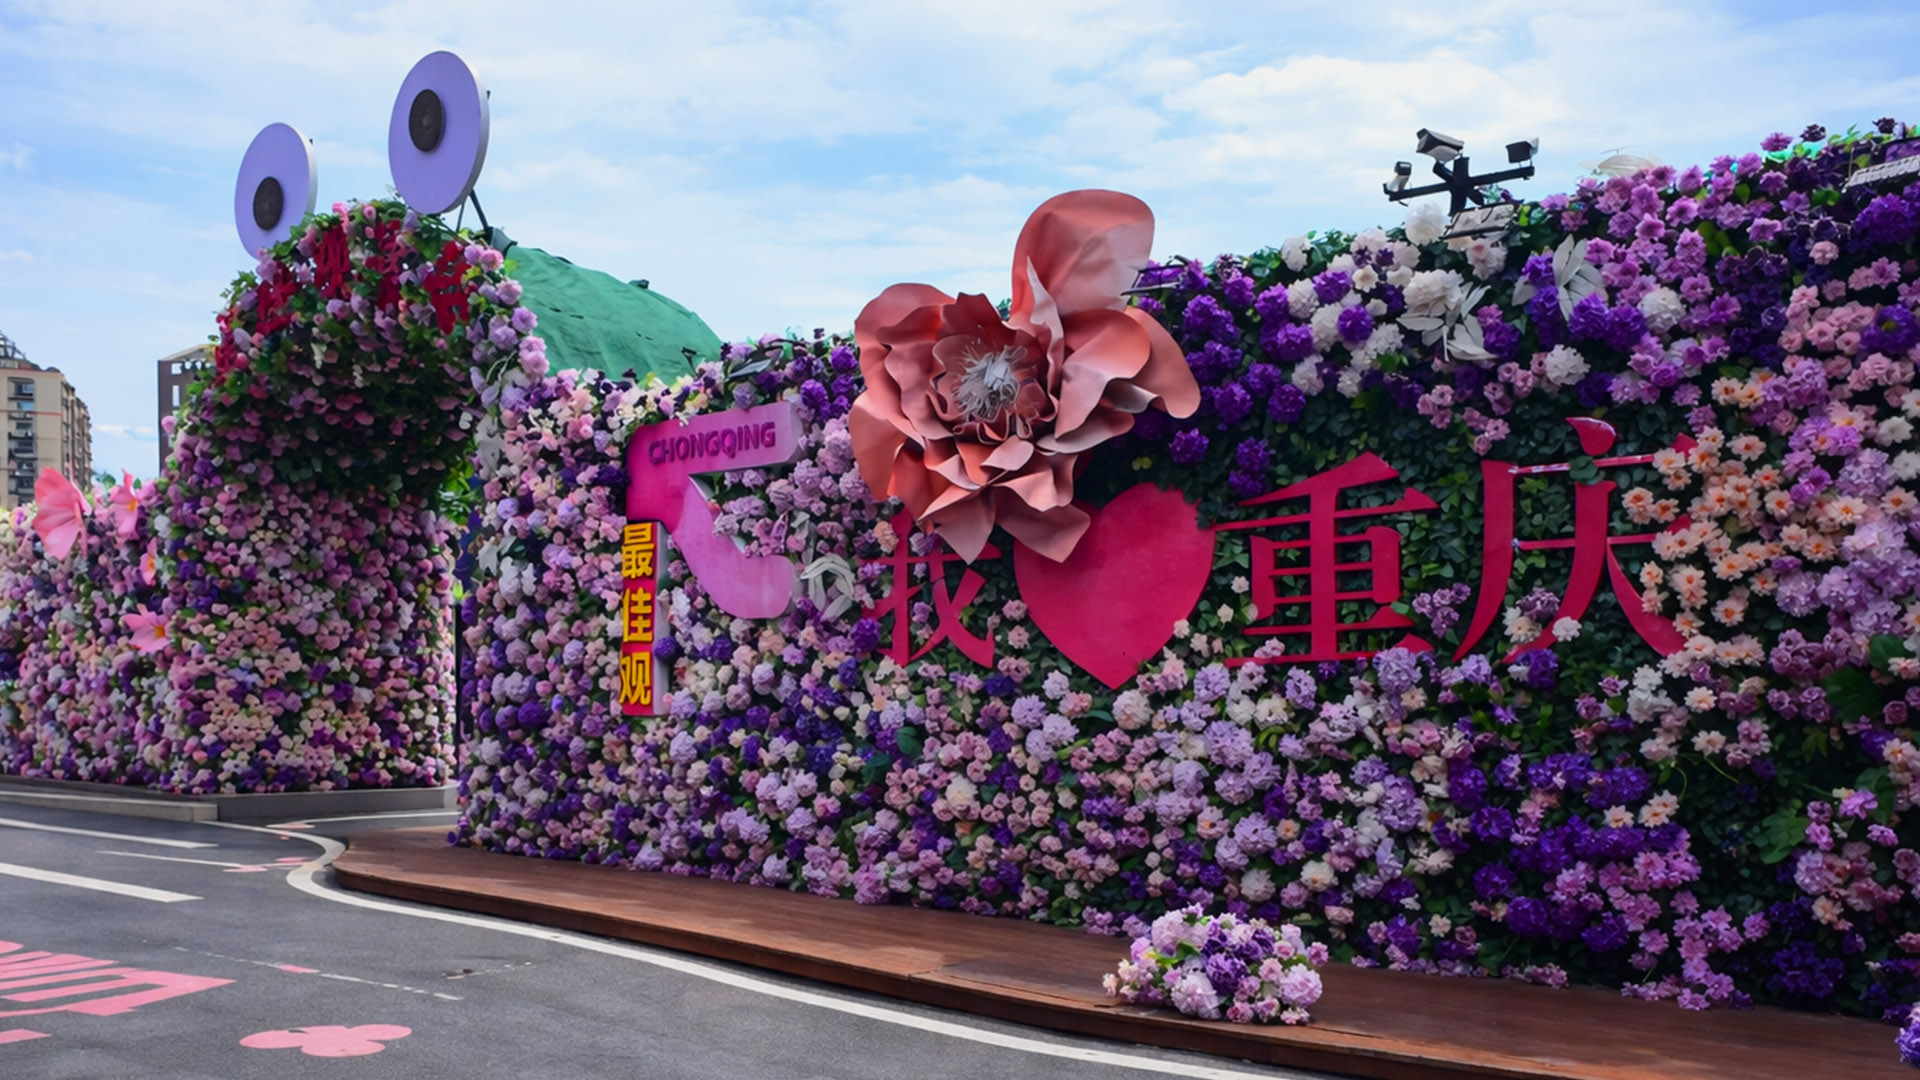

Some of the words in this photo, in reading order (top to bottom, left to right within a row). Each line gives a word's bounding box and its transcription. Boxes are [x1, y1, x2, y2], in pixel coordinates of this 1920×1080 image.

[649, 422, 776, 466] CHONGQING
[619, 522, 654, 706] 最佳观
[1214, 417, 1697, 668] 重庆
